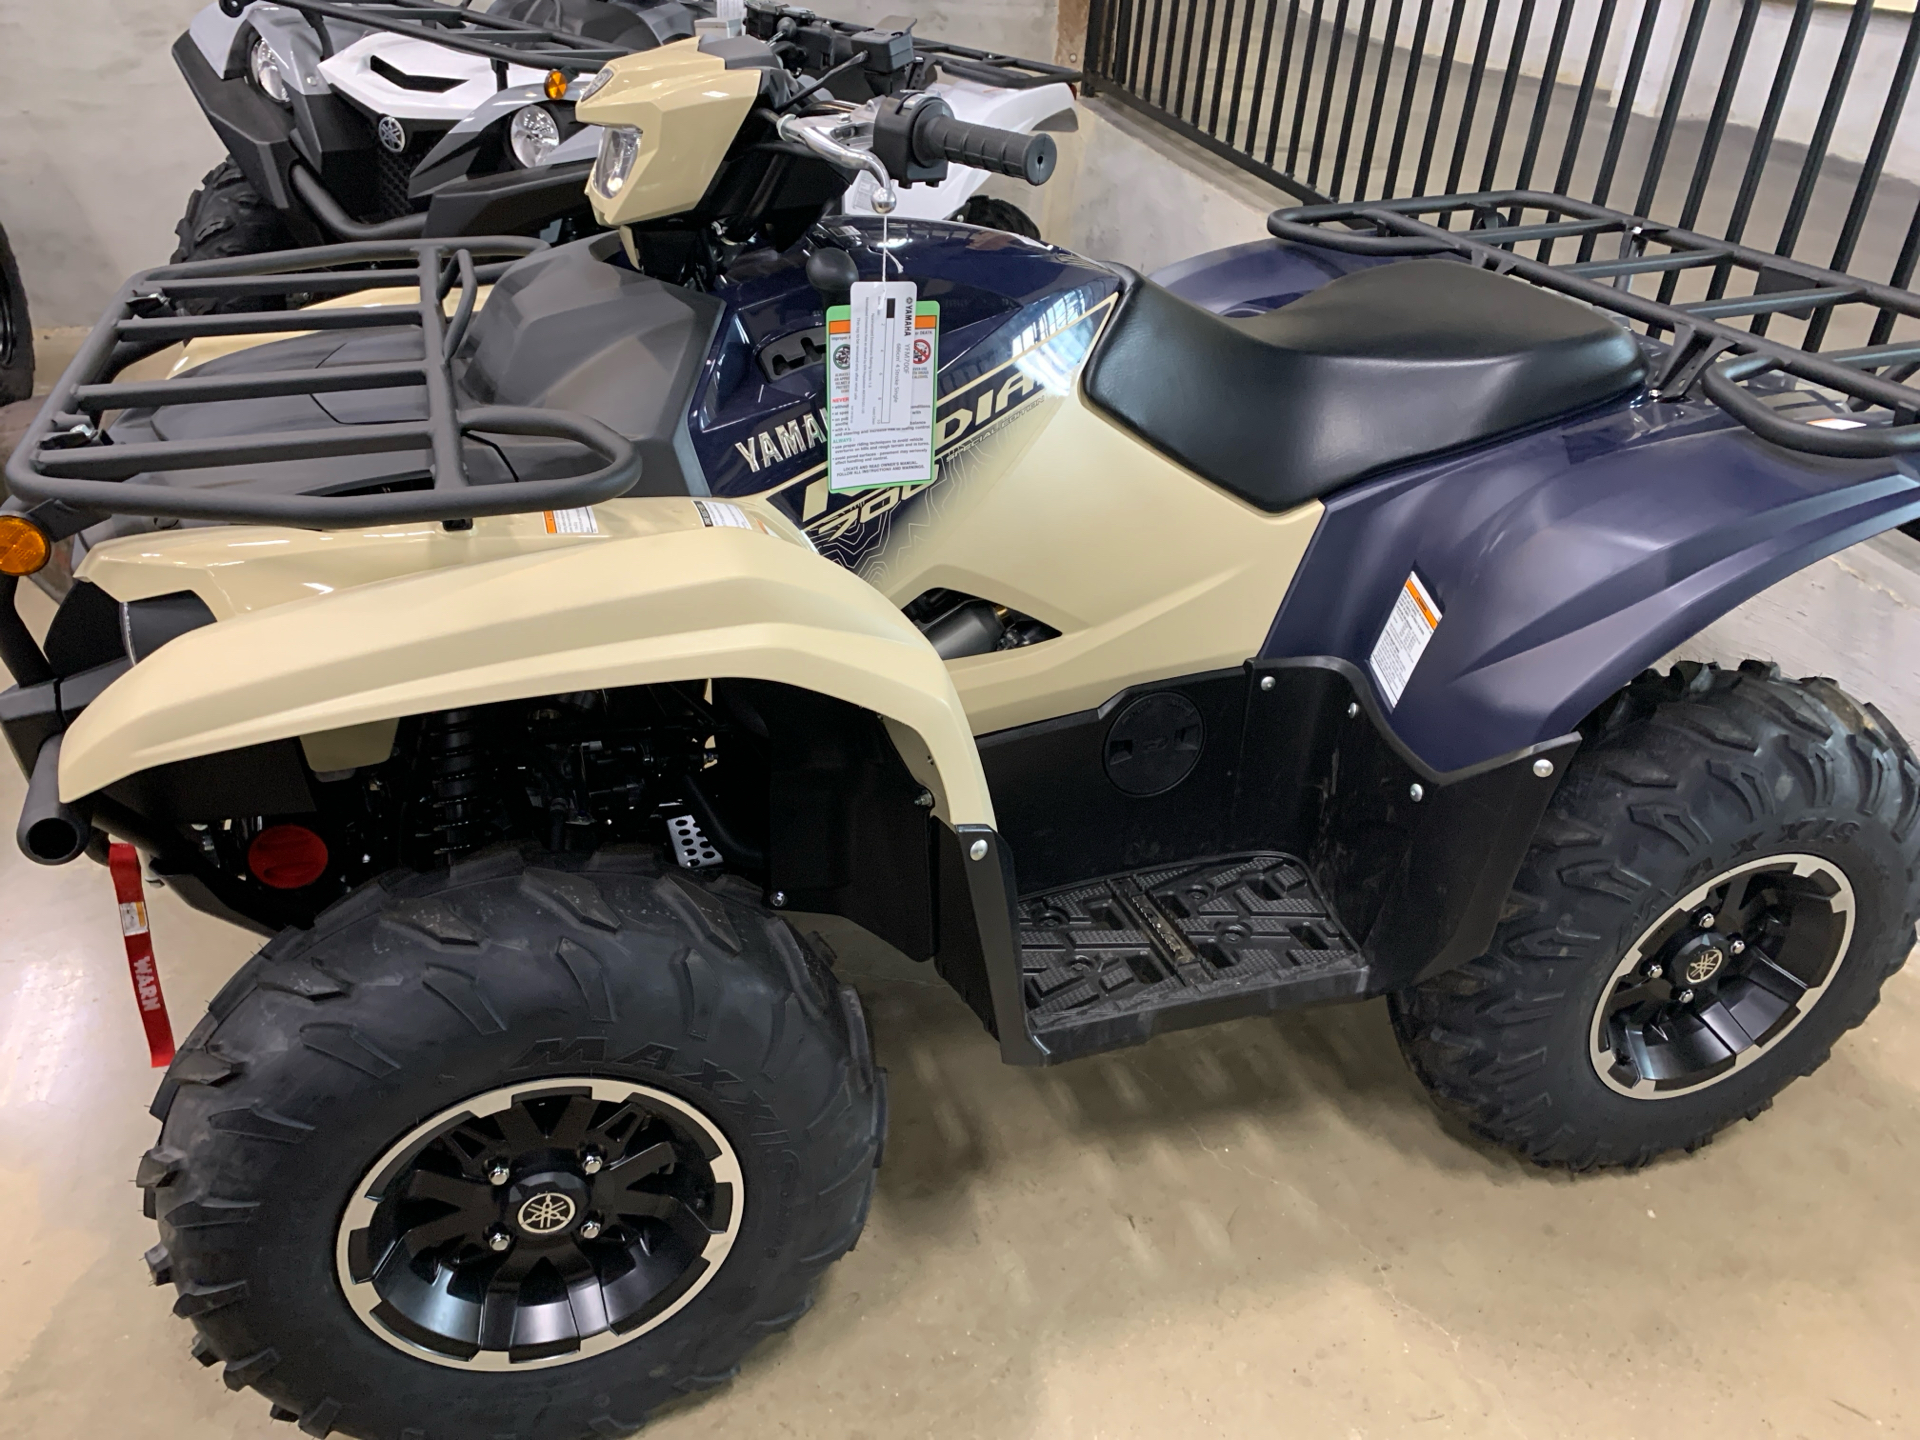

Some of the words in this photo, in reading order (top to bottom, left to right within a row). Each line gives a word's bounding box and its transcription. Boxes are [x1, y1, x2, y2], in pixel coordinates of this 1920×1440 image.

[904, 304, 913, 337] YAMAHA
[903, 343, 911, 374] YFM700F
[735, 407, 828, 473] YAMA
[946, 426, 1000, 462] SPECIAL
[1001, 395, 1045, 428] EDITION
[133, 955, 160, 1012] WARN
